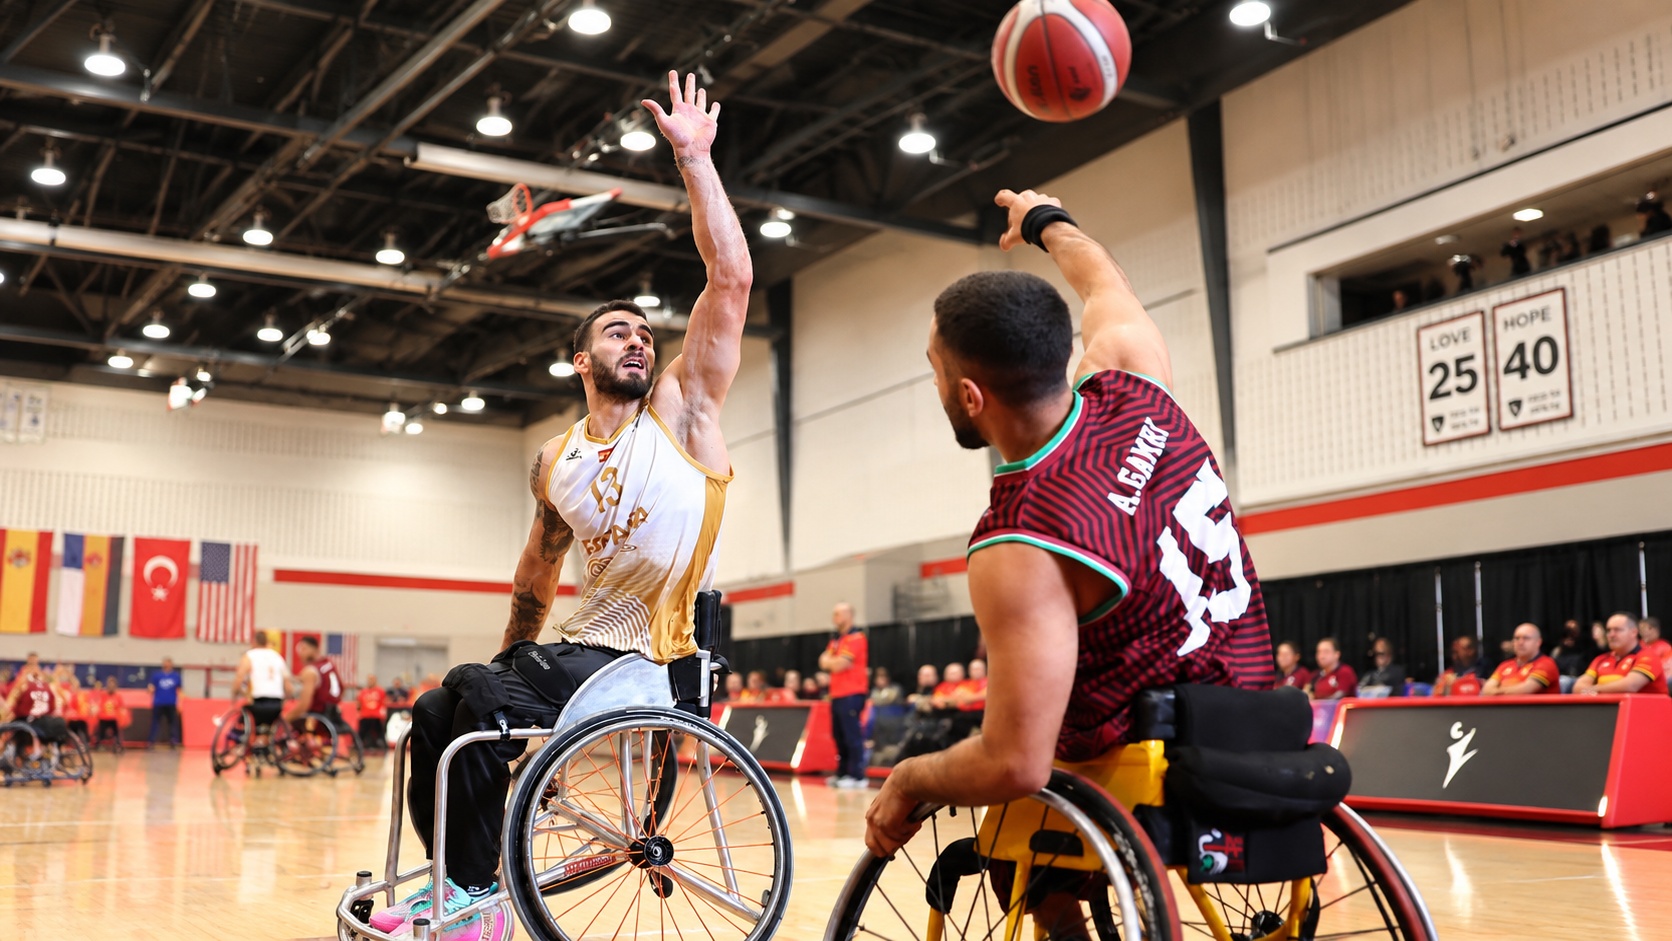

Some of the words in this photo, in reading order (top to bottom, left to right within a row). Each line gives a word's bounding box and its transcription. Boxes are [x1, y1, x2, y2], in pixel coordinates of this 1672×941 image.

[1430, 326, 1471, 351] LOVE
[1504, 307, 1552, 331] HOPE
[1429, 354, 1478, 400] 25
[1503, 335, 1559, 379] 40
[591, 466, 623, 513] 13
[1156, 456, 1252, 657] 15
